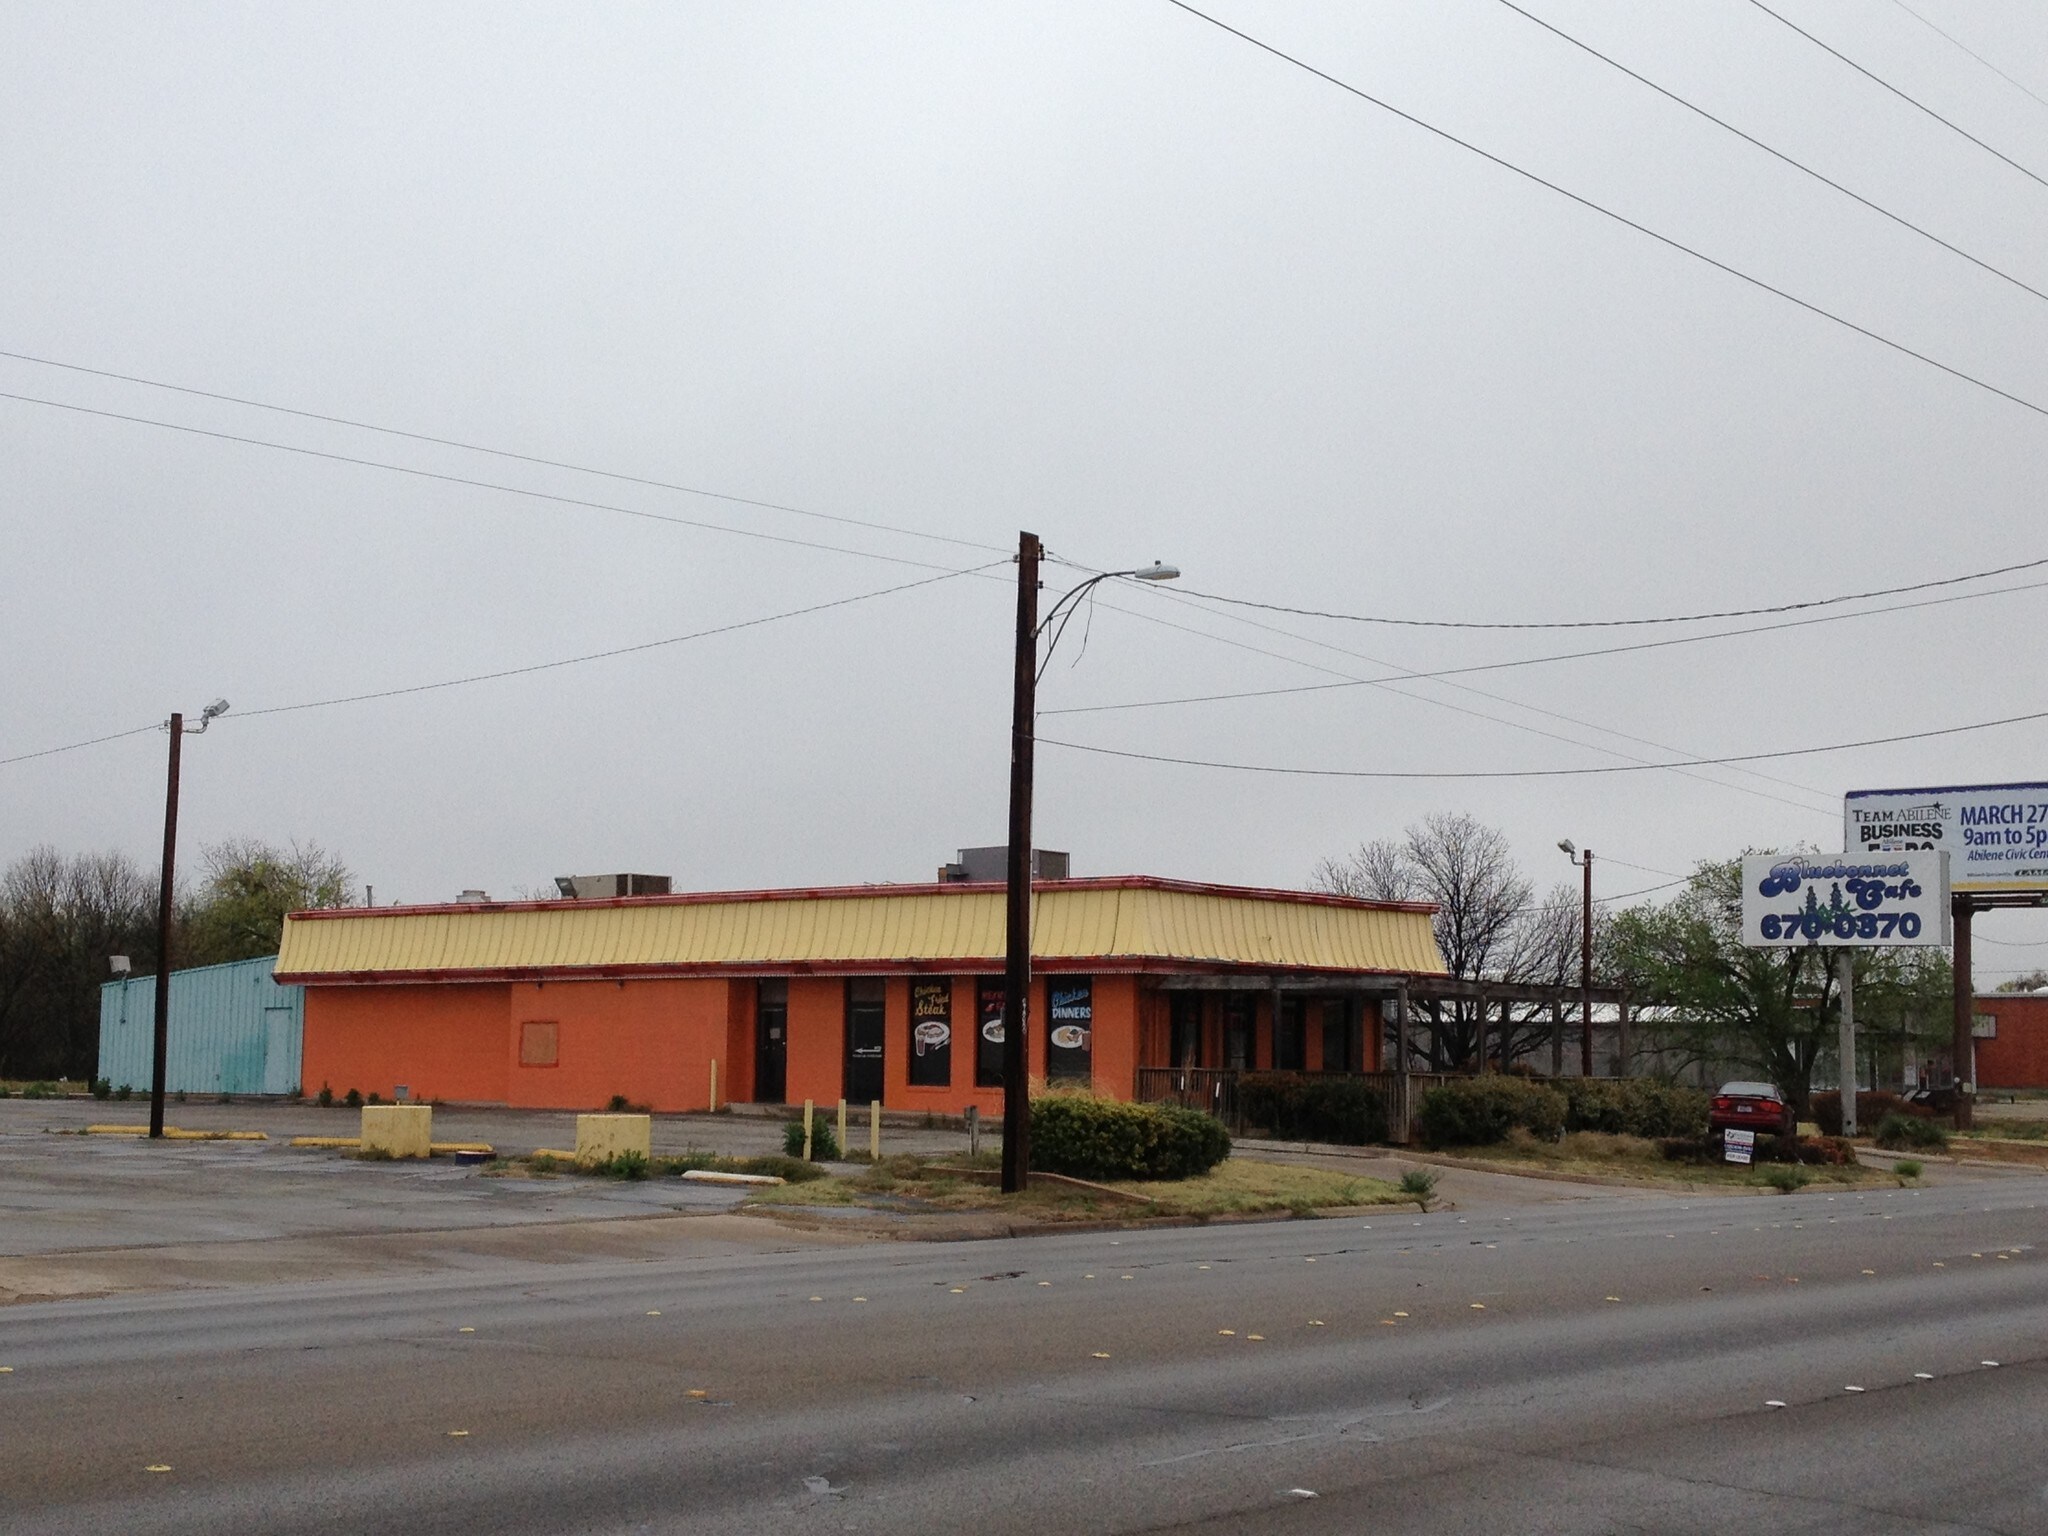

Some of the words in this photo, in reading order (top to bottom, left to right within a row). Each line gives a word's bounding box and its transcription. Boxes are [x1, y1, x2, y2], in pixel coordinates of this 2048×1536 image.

[1852, 809, 1893, 822] TEAM
[1896, 808, 1952, 821] ABILENE
[1960, 804, 2023, 826] MARCH
[2027, 804, 2048, 823] 27
[1860, 822, 1943, 843] BUSINESS
[1963, 828, 2001, 846] 9am
[2004, 827, 2022, 845] to
[1967, 849, 2004, 861] Abilene
[2005, 848, 2028, 860] Civic
[1759, 857, 1910, 898] Bluebonnet
[1845, 878, 1922, 910] Cafe
[915, 1000, 947, 1017] Steak
[1052, 1006, 1092, 1019] DINNERS
